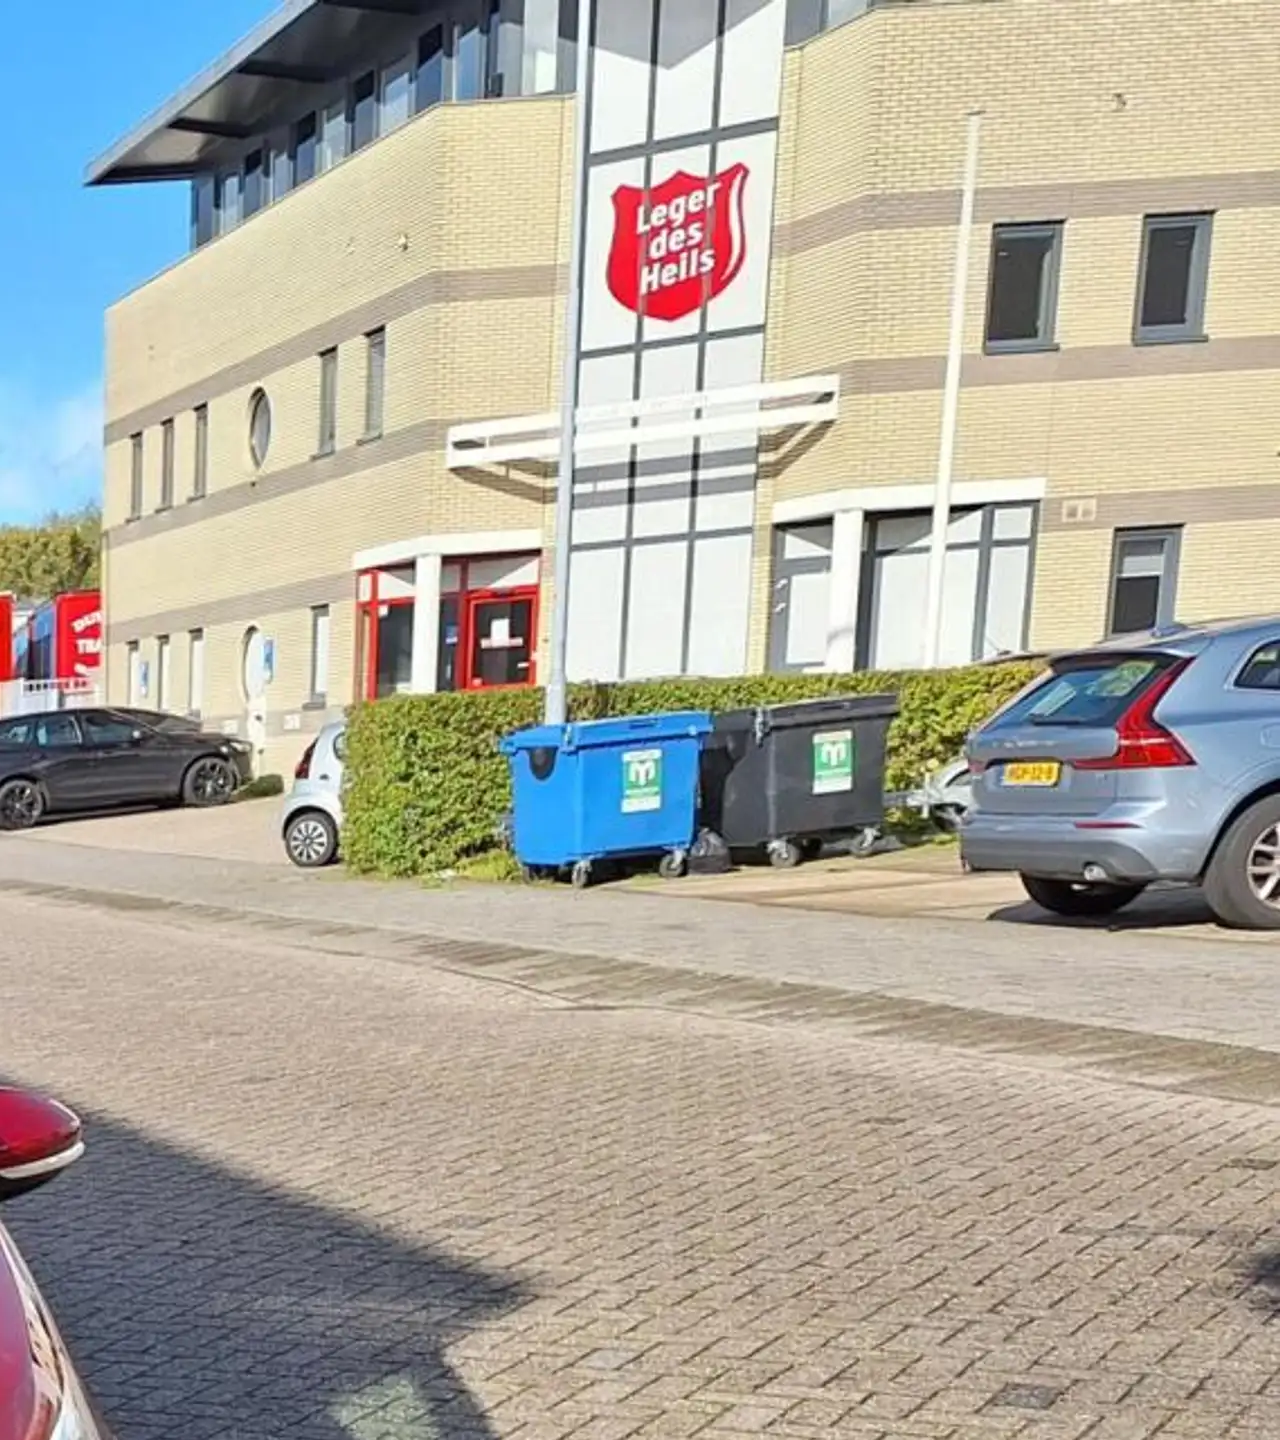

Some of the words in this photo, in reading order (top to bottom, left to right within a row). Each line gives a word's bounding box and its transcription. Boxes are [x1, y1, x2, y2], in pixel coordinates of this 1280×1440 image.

[636, 182, 722, 235] Leger
[648, 221, 704, 260] des
[640, 249, 716, 296] Heils
